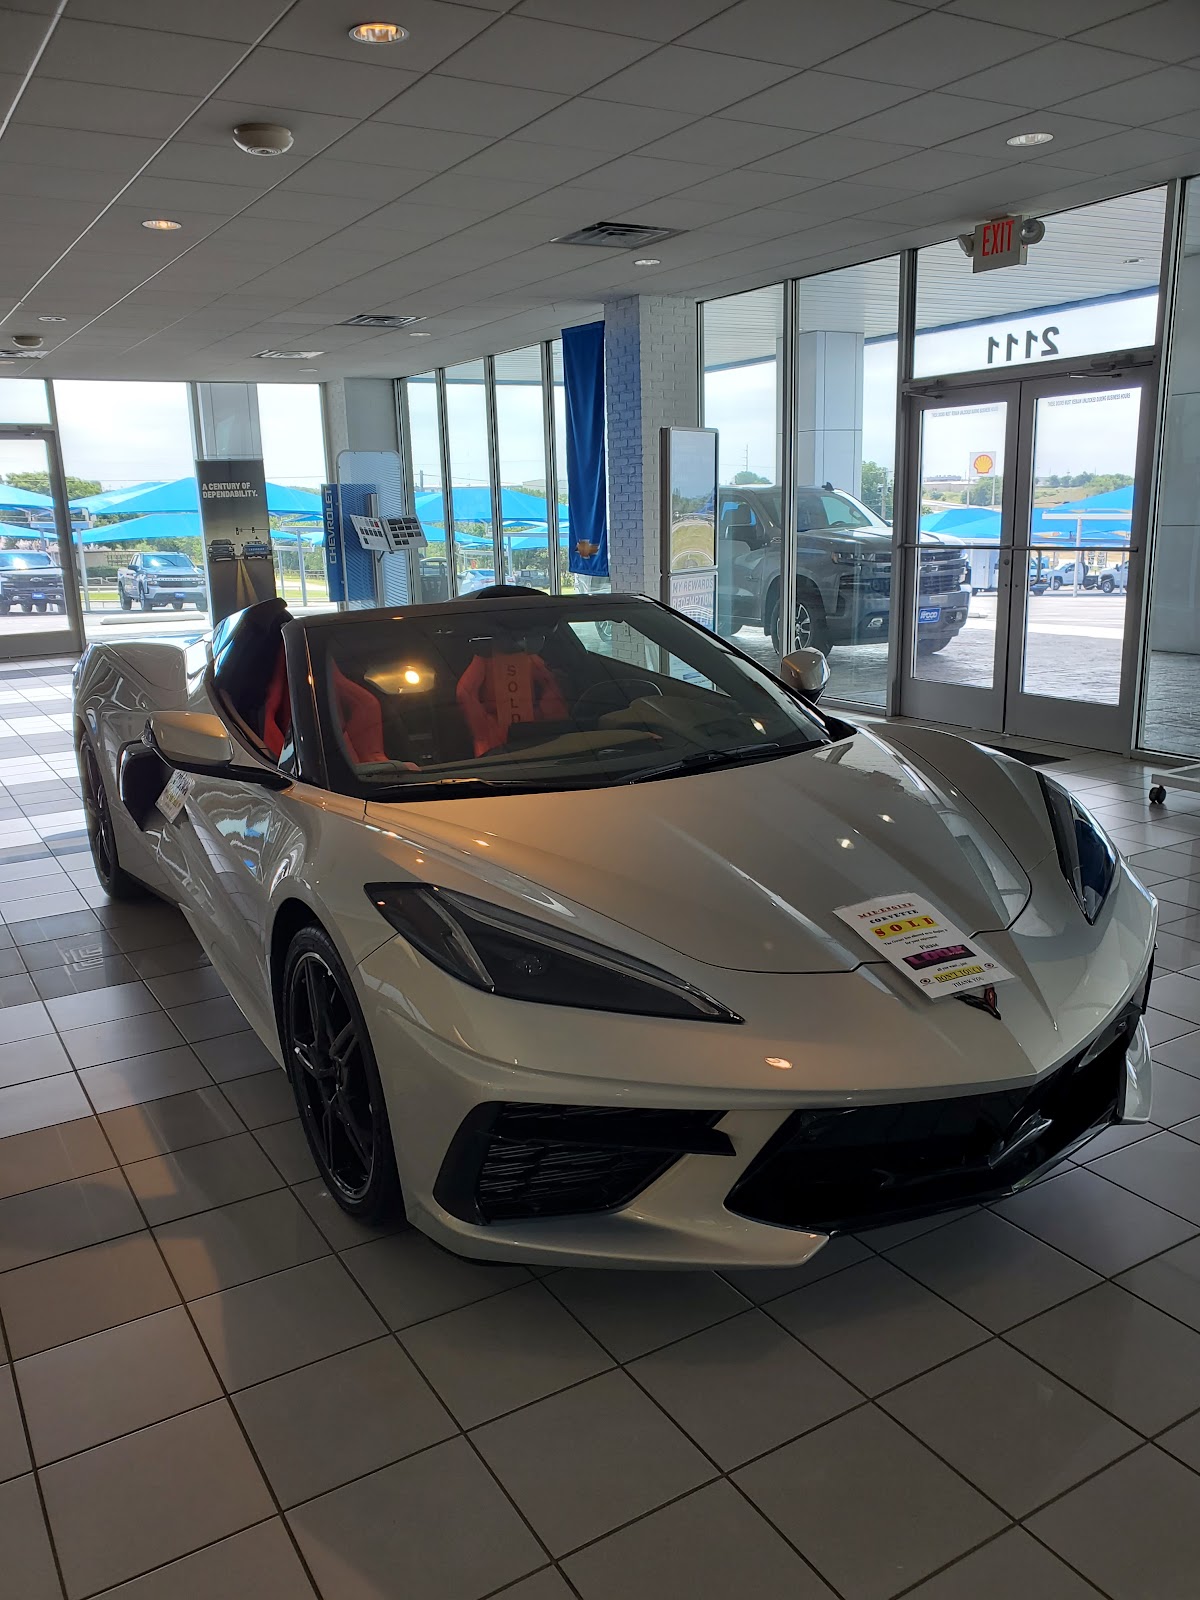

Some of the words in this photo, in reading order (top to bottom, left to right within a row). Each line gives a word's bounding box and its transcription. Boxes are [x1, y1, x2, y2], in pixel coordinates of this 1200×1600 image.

[982, 220, 1015, 256] EXIT
[202, 489, 258, 498] DEPENDABILITY.
[208, 482, 240, 490] CENTURY
[324, 488, 337, 564] CHEVROLET
[672, 581, 683, 594] MY
[684, 578, 713, 592] REWARDS
[672, 593, 713, 609] REDEMPTION
[507, 664, 521, 723] SOLD
[869, 909, 919, 924] CORVETTE
[874, 917, 934, 938] SOLD
[960, 965, 984, 977] TOUCH
[952, 978, 973, 988] THANK
